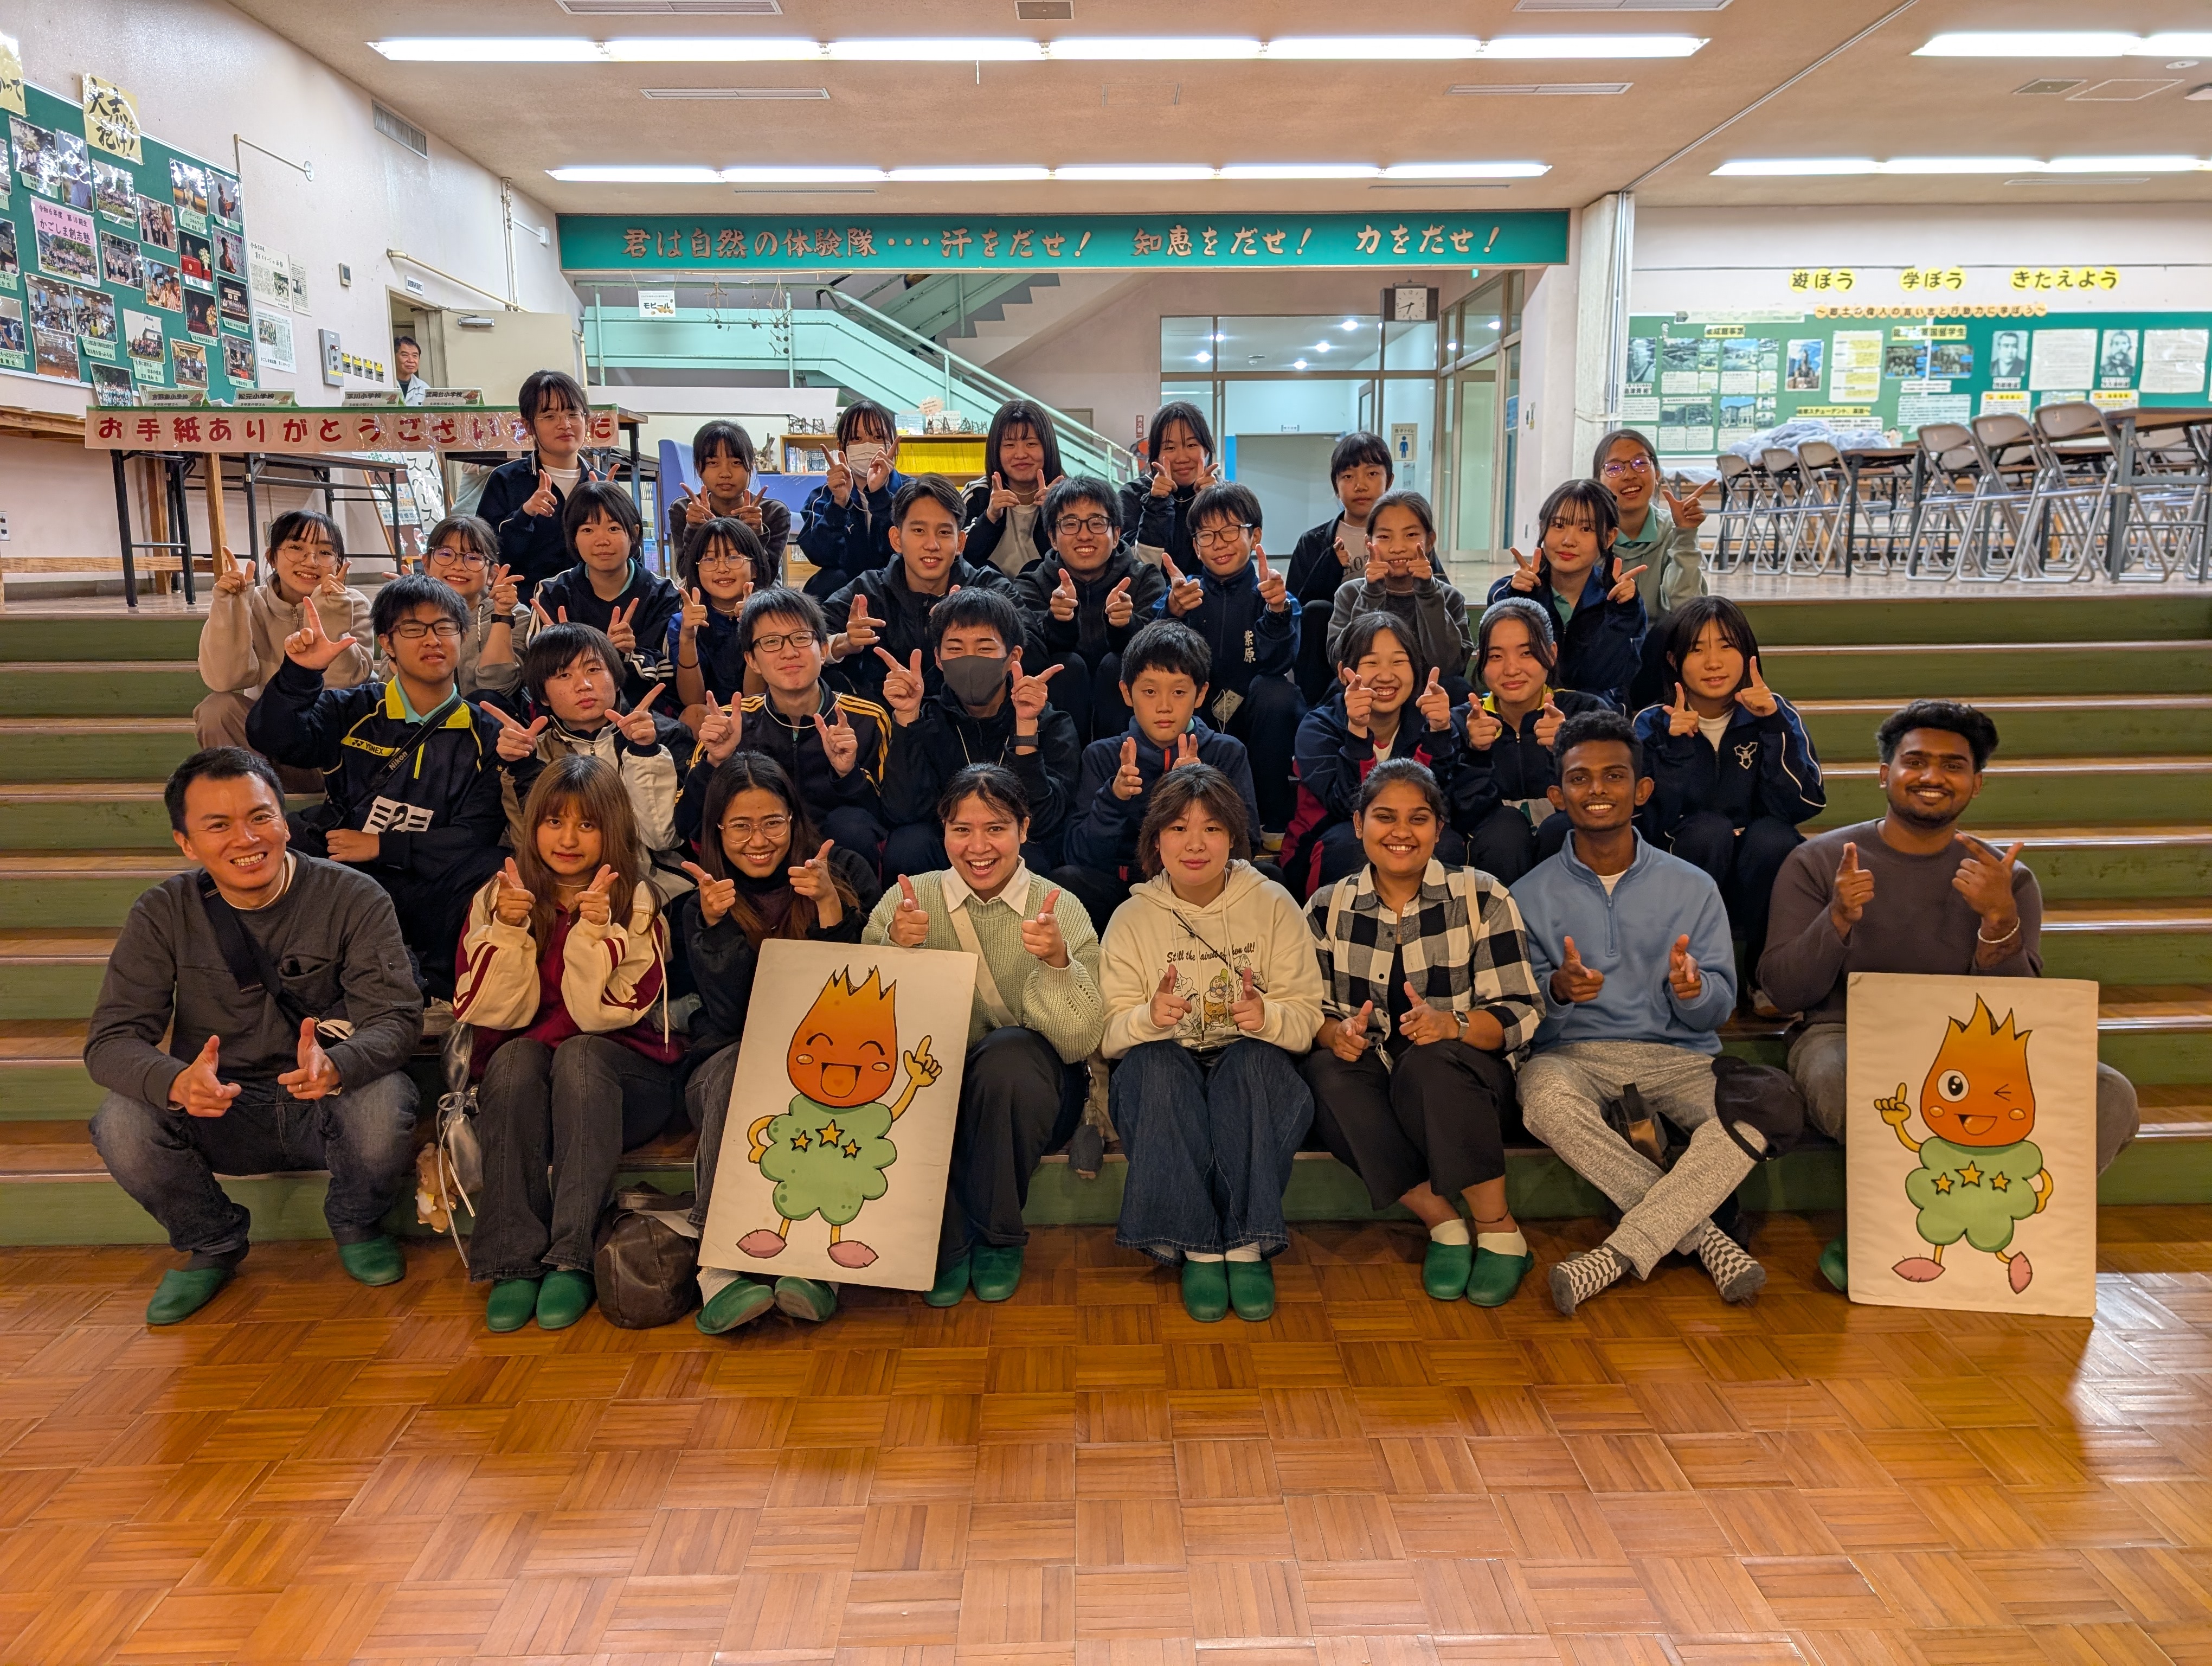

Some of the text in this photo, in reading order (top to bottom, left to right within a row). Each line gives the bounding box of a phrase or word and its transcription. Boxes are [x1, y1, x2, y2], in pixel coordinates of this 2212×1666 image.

[38, 204, 63, 219] 令和6年度
[67, 214, 88, 227] 第10期生
[40, 219, 91, 244] かごしま創志塾
[1132, 225, 1312, 256] 知恵をだせ！
[1356, 223, 1500, 254] 力をだせ！
[1792, 270, 2117, 289] 遊ぼう 学ぼう きたえよう
[1244, 630, 1256, 663] 紫原
[365, 742, 384, 754] YONEX
[388, 751, 408, 771] Nikon
[1167, 950, 1184, 963] Still
[1186, 950, 1196, 961] the
[1244, 941, 1255, 953] all!
